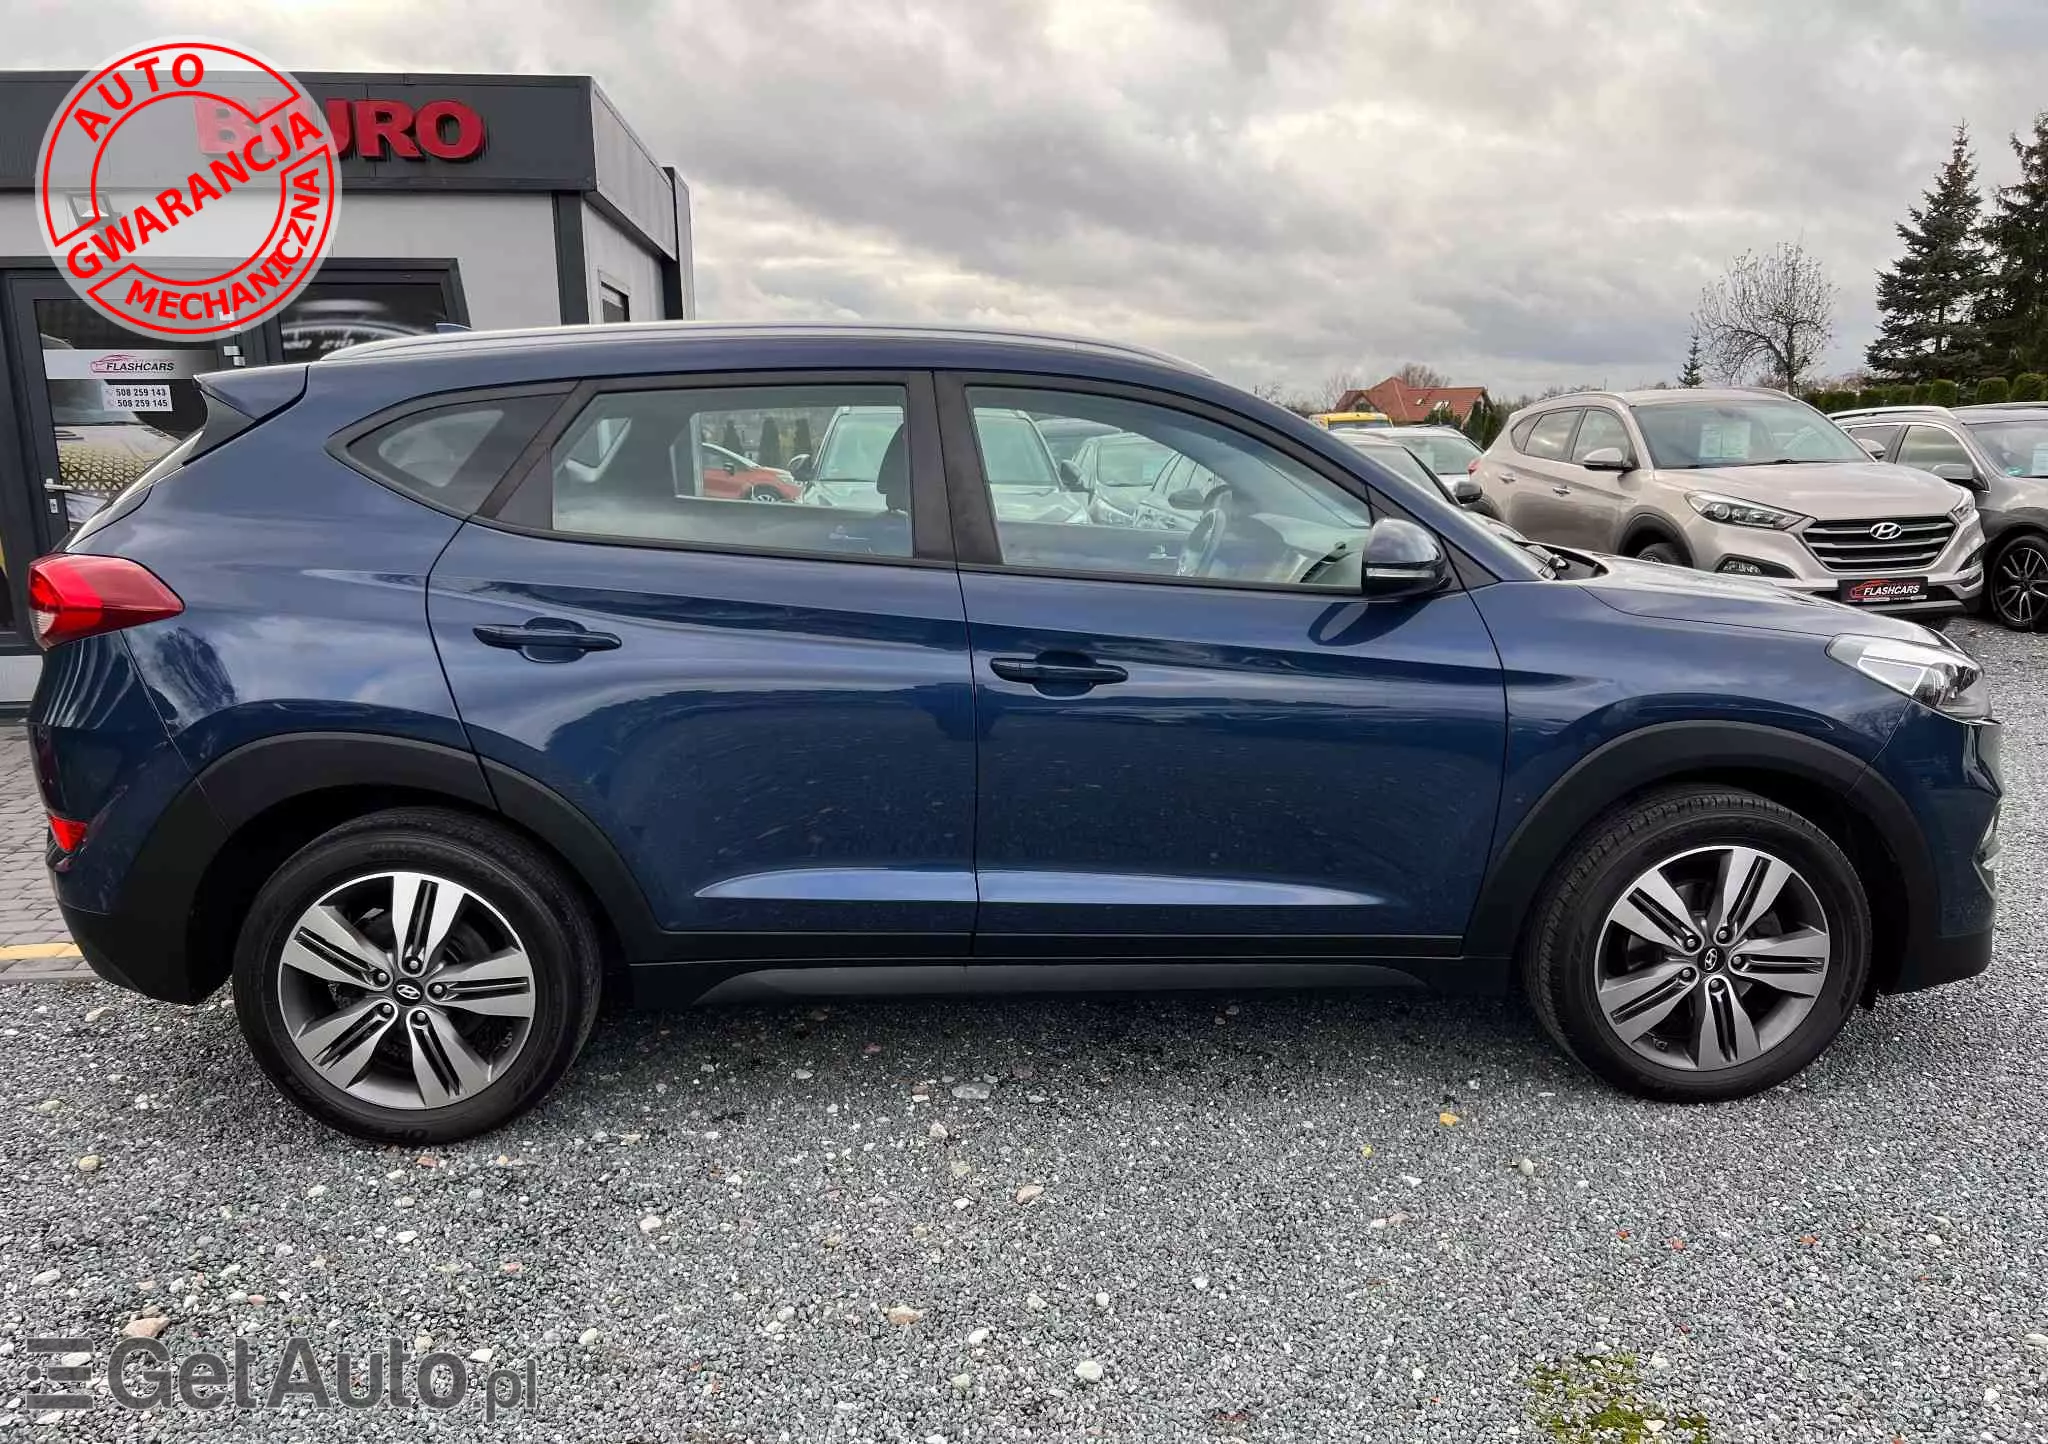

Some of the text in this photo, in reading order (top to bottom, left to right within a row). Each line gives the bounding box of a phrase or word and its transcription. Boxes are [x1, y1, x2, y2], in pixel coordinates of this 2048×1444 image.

[106, 362, 175, 371] FLASHCARS
[134, 388, 149, 397] 259
[1863, 585, 1920, 596] FLASHCARS
